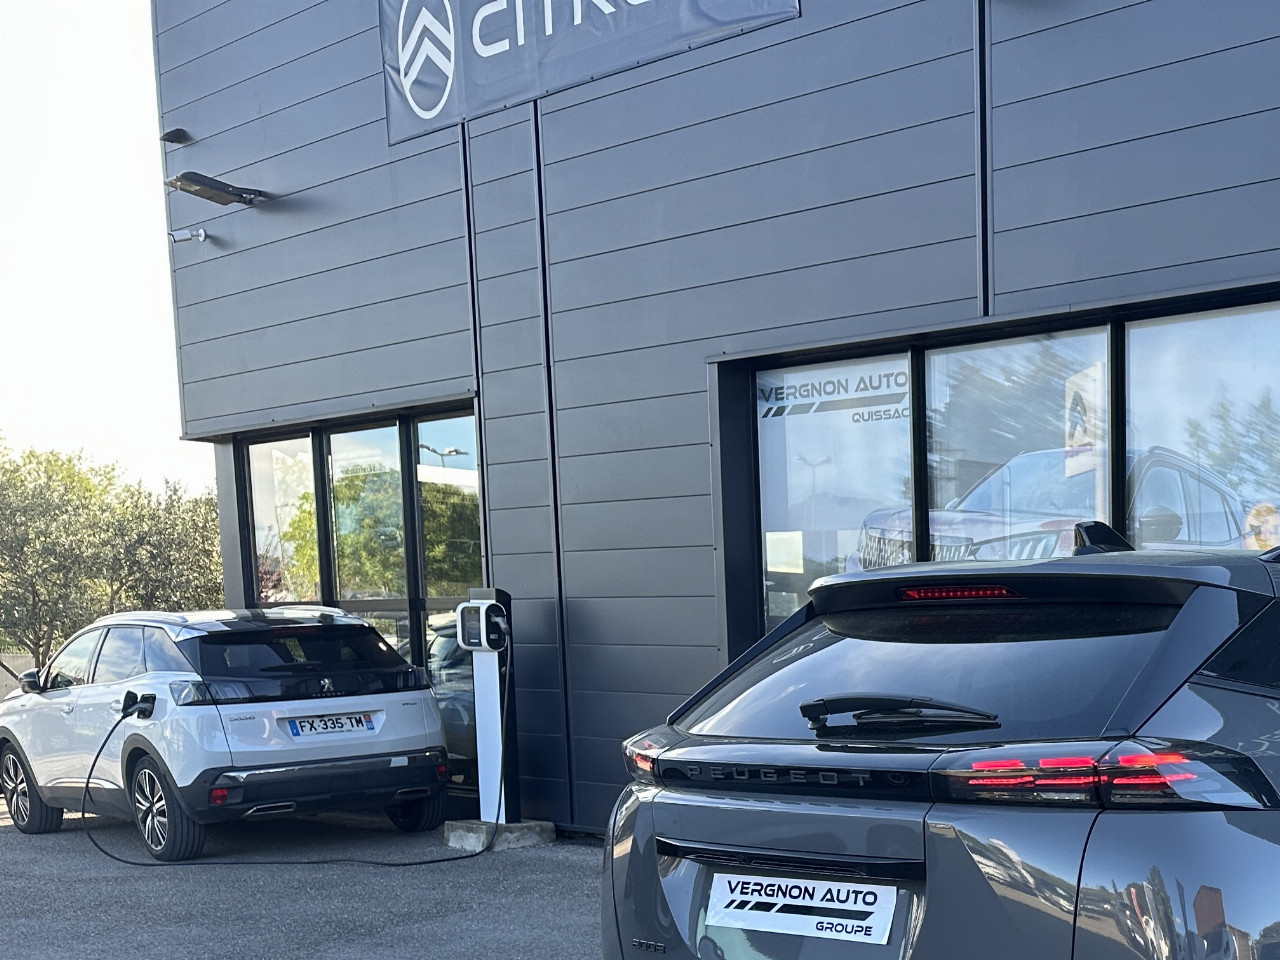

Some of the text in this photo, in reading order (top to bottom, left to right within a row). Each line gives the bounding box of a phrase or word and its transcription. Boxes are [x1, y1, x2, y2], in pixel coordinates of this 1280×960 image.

[758, 371, 909, 404] VERGNON AUTO
[851, 406, 909, 423] QUISSAC
[685, 765, 871, 787] PEUGEOT
[727, 880, 878, 906] VERGNON AUTO
[815, 921, 873, 937] GROUPE
